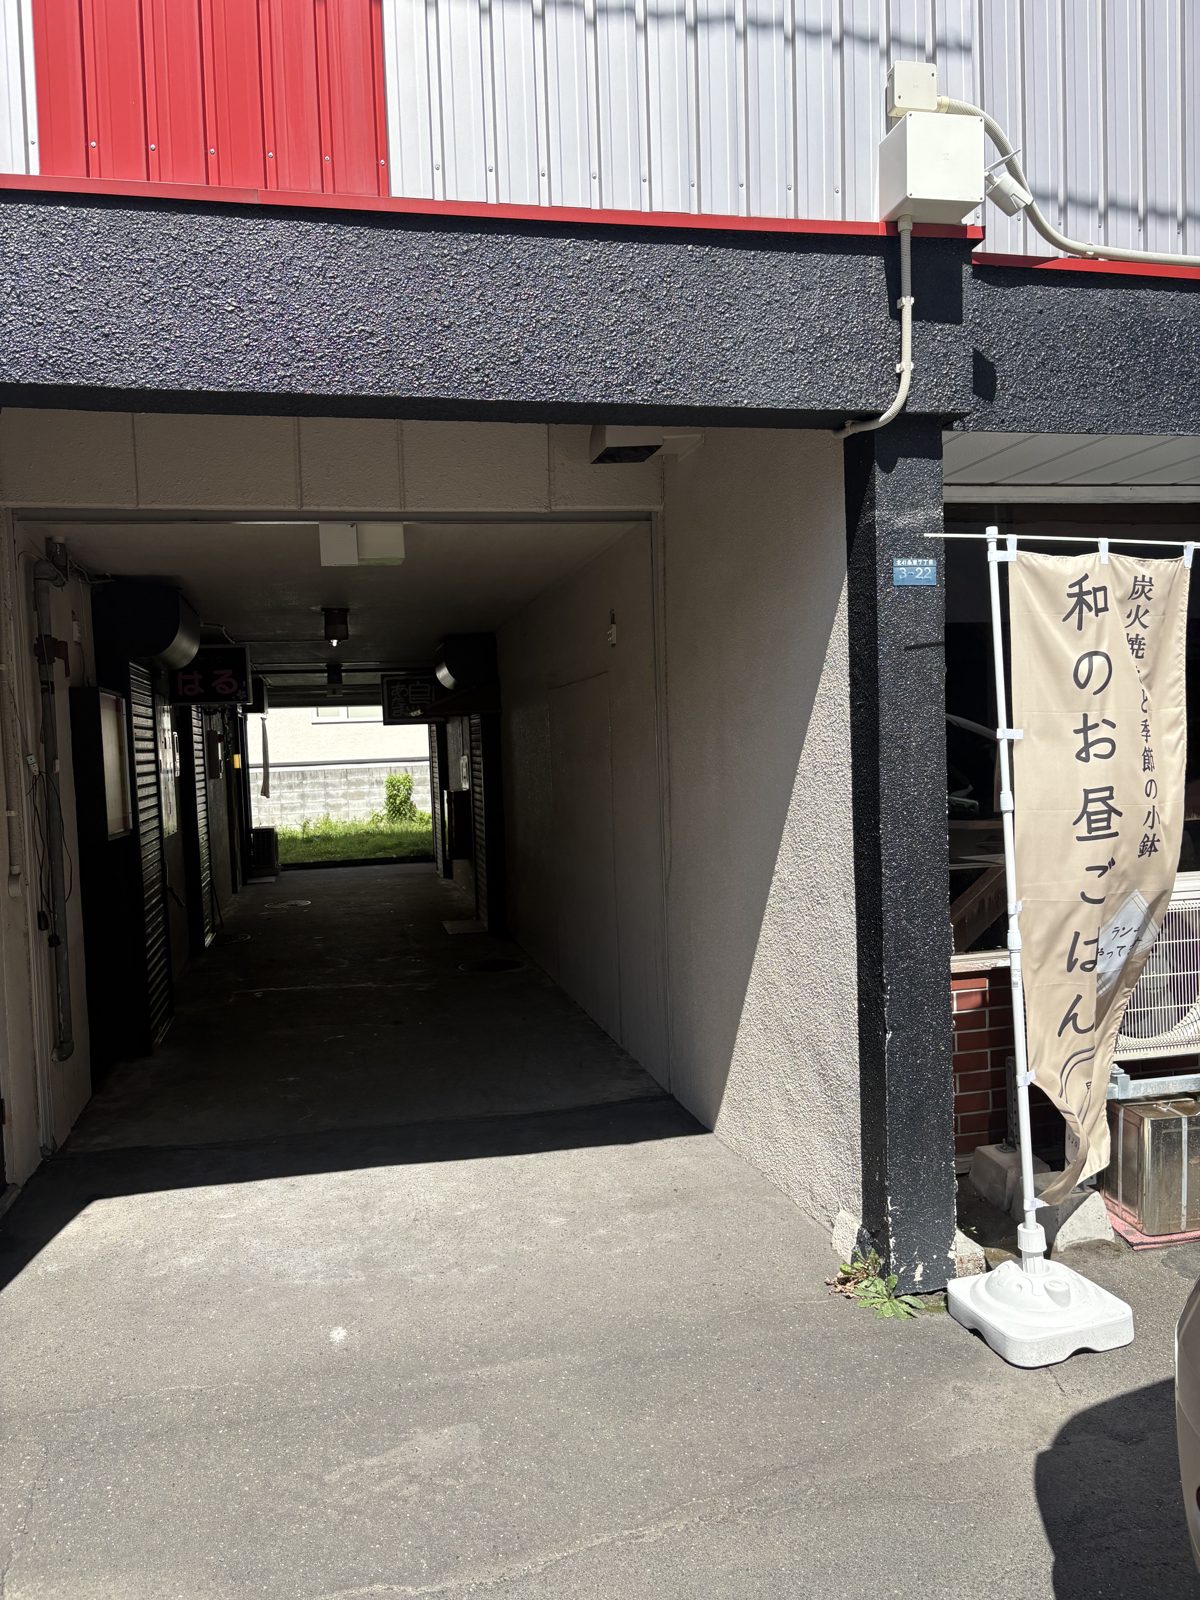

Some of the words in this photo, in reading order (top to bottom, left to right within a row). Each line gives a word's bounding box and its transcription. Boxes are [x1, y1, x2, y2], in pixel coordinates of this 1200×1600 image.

[899, 567, 931, 579] 3-22
[177, 669, 239, 696] はる
[1123, 574, 1161, 858] 炭火焼と季節の小鉢
[1057, 572, 1123, 1039] 和のお昼ごはん
